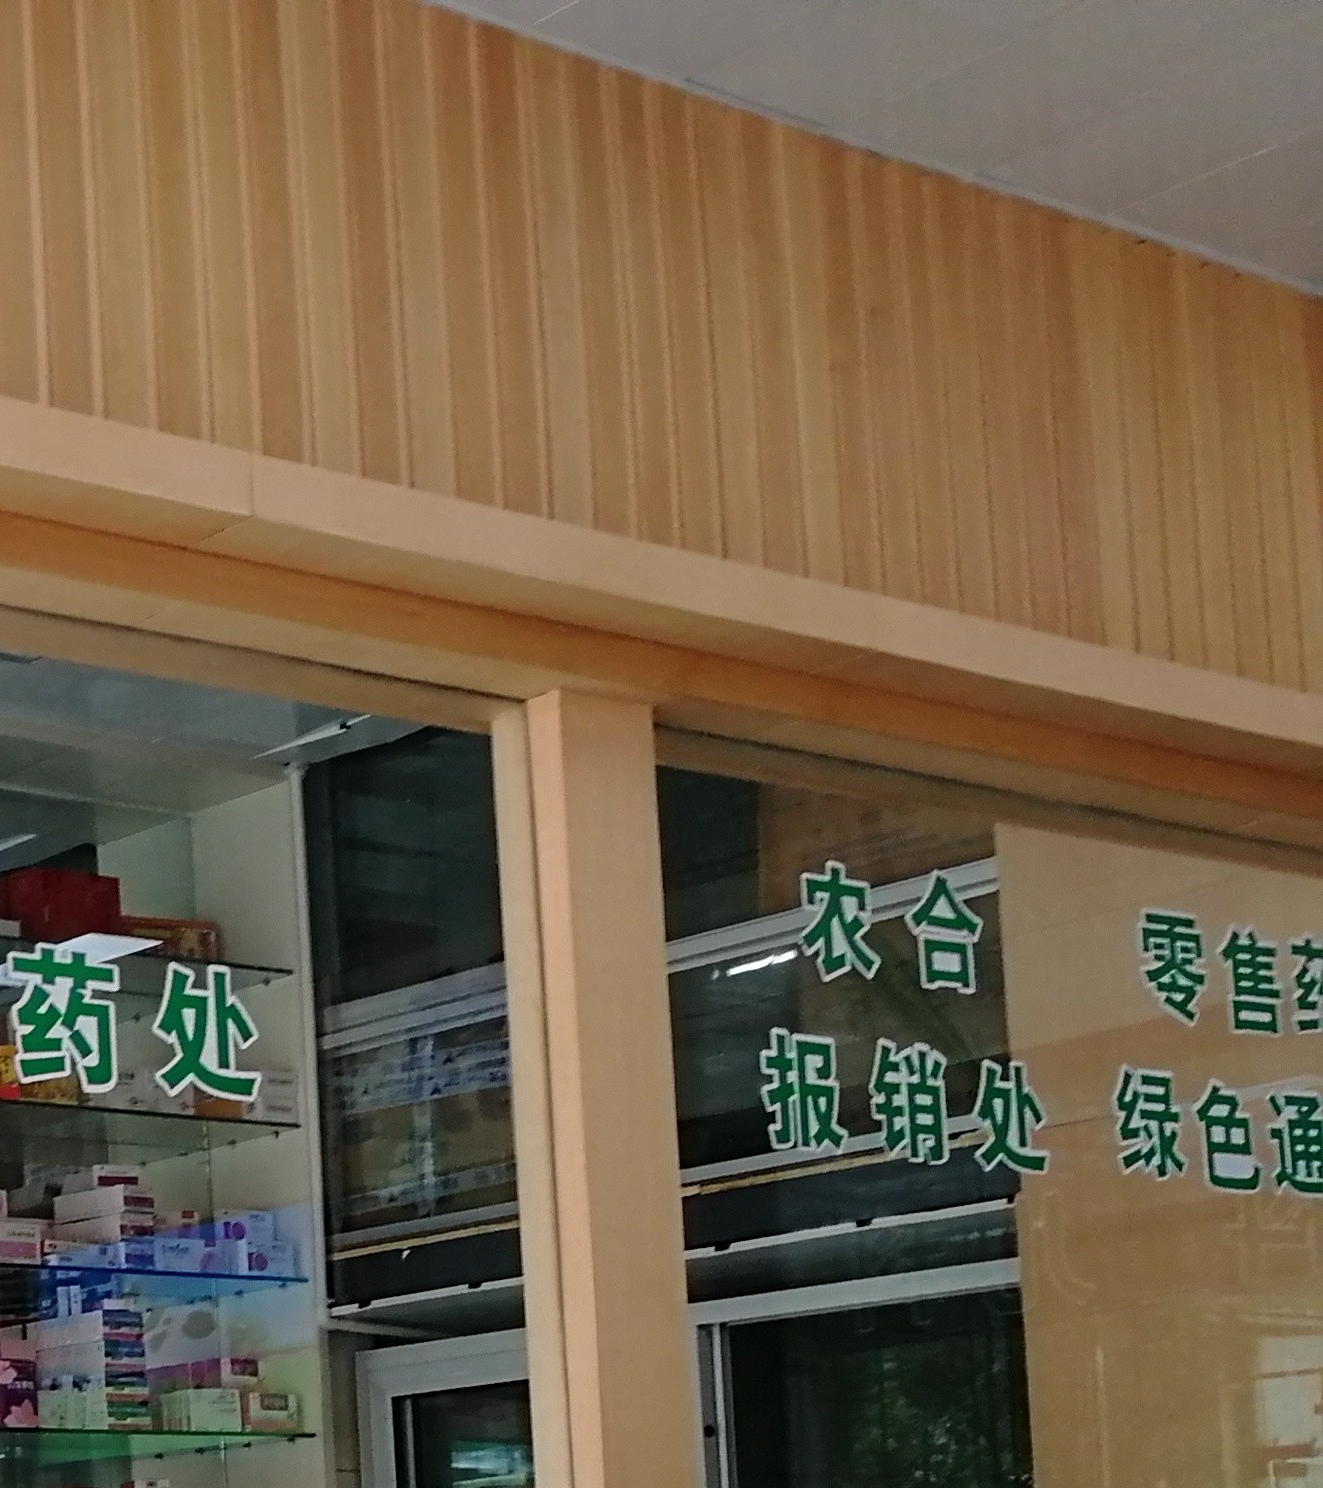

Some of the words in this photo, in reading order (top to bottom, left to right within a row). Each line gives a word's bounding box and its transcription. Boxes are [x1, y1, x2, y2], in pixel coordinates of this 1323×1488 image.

[801, 866, 980, 986] 农合
[763, 1033, 1047, 1171] 报销处
